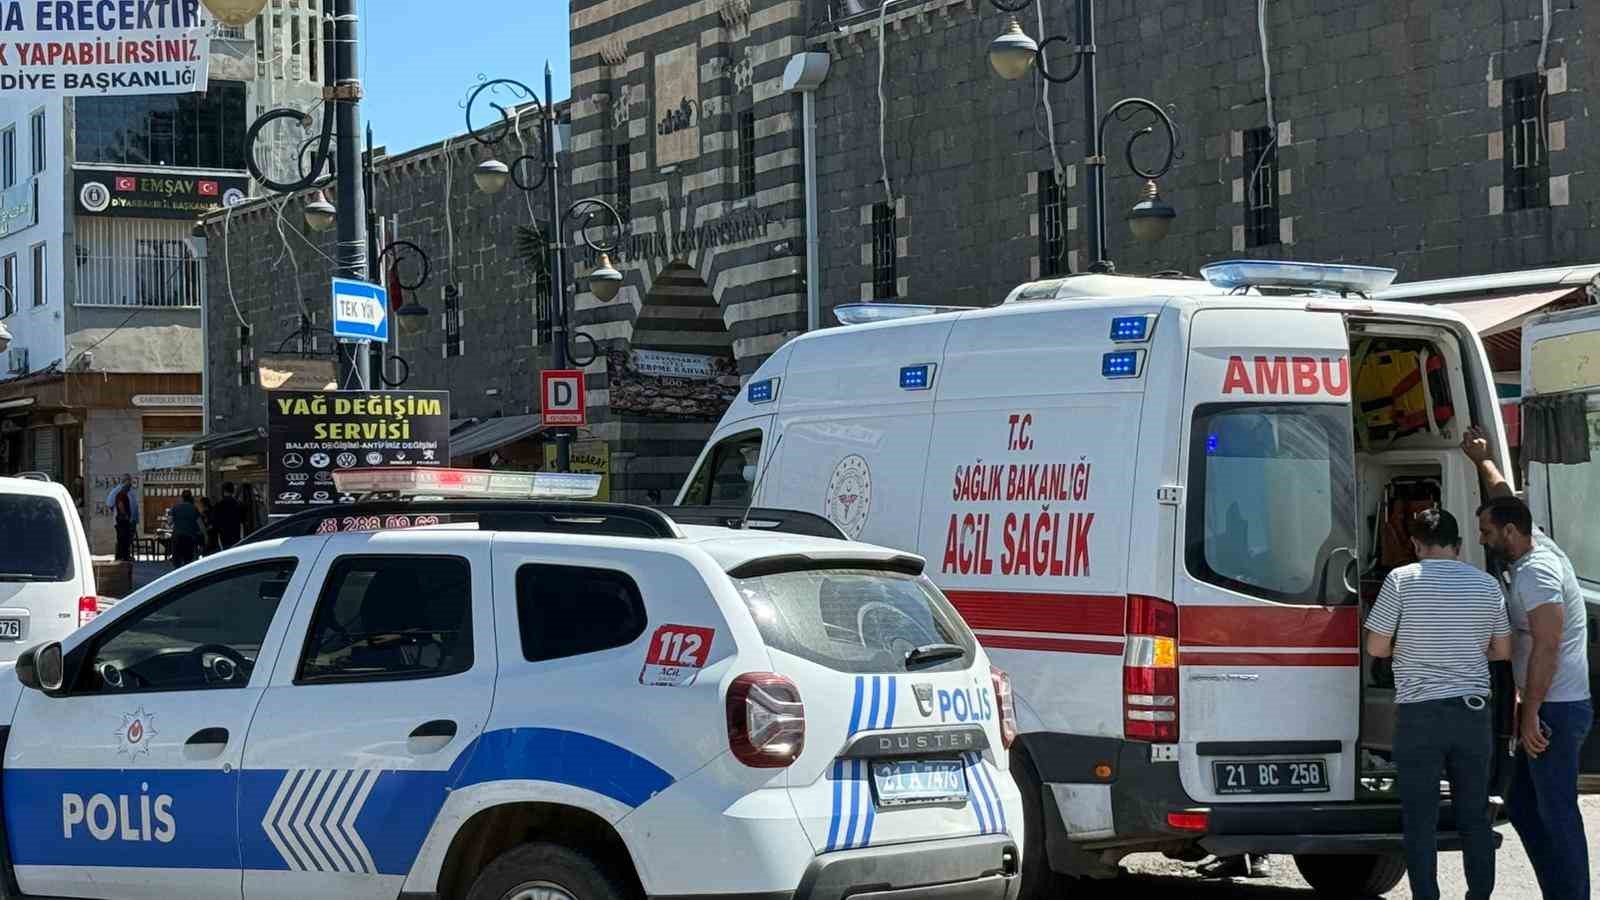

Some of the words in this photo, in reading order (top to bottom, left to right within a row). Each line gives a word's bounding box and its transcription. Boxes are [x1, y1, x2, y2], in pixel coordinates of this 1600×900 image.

[141, 178, 195, 197] EMŞAV
[340, 300, 358, 318] TEK
[1222, 356, 1350, 396] AMBU
[277, 395, 327, 416] YAĞ
[335, 395, 441, 420] DEĞİŞİM
[553, 381, 572, 406] D
[314, 420, 410, 440] SERVİSİ
[1008, 413, 1033, 450] T.C.
[953, 457, 1005, 501] SAĞLIK
[1006, 455, 1092, 501] BAKANLIĞI
[942, 512, 993, 575] ACİL
[1001, 504, 1096, 577] SAĞLIK
[658, 632, 702, 663] 112
[937, 679, 993, 723] POLİS
[879, 733, 974, 750] DUSTER
[1226, 765, 1247, 787] 21
[1258, 764, 1280, 786] BC
[1289, 764, 1320, 785] 258
[62, 782, 176, 843] POLİS
